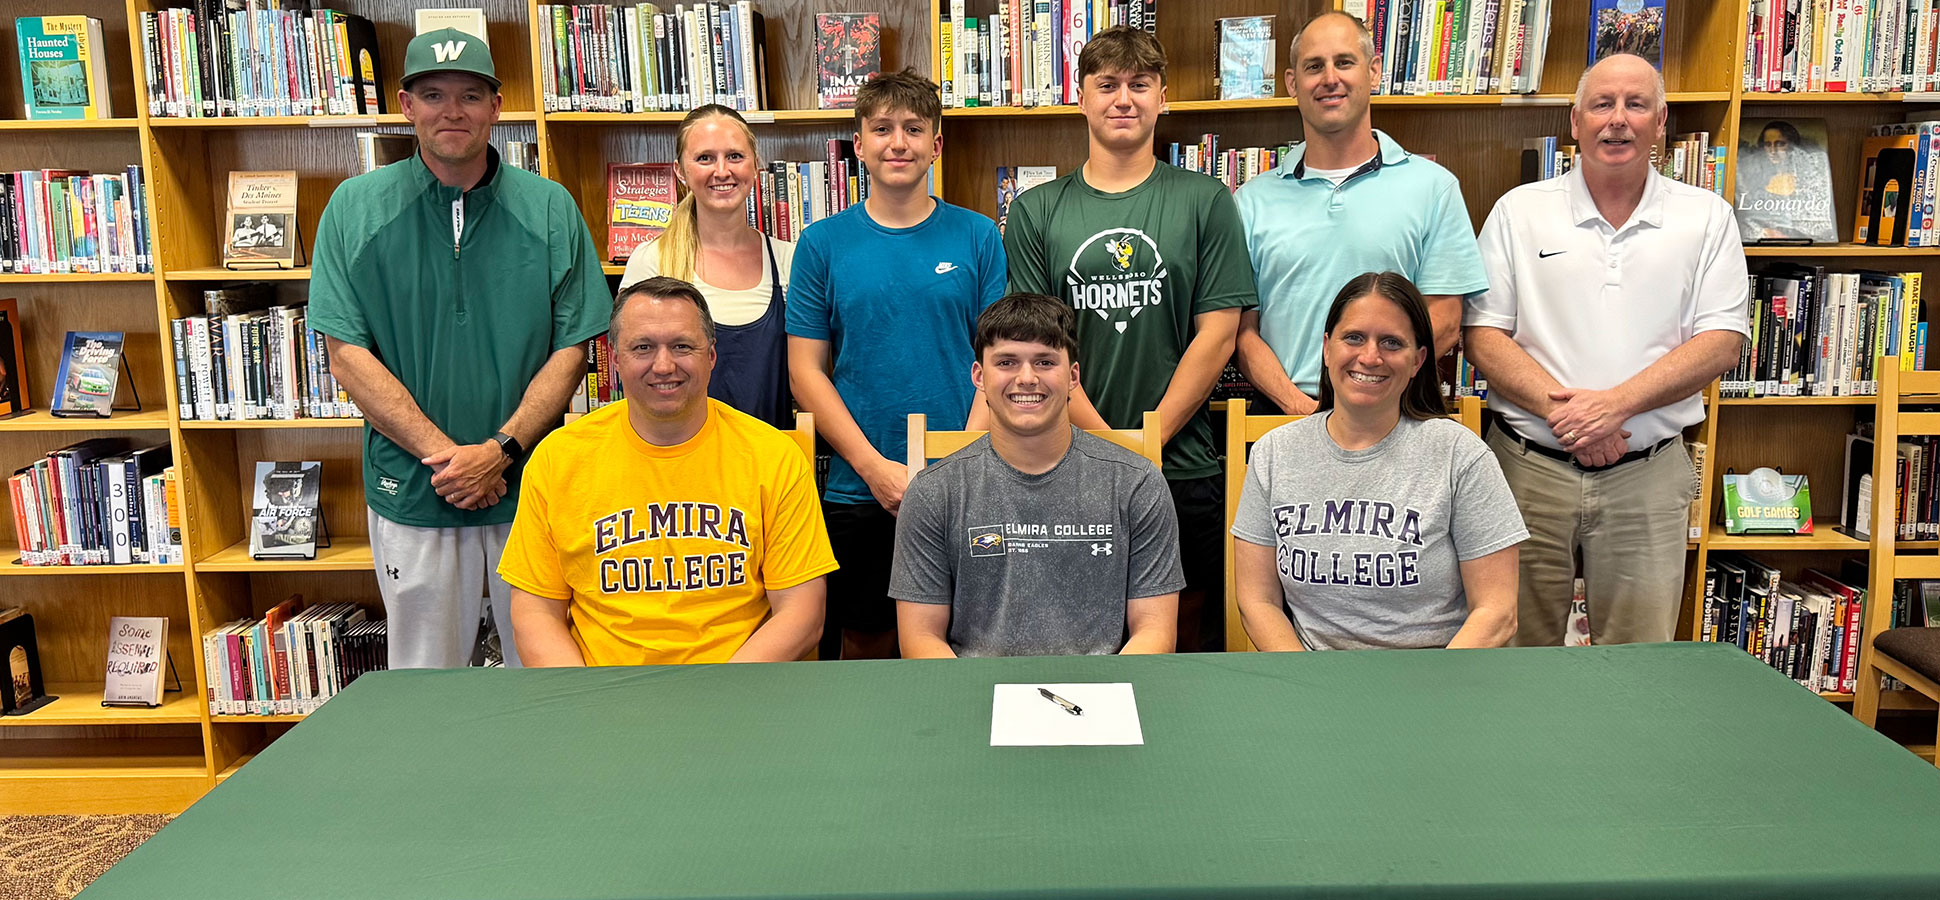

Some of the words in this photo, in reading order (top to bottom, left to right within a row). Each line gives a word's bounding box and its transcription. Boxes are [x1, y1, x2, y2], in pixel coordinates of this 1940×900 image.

[555, 9, 562, 17] 13
[697, 8, 705, 19] THE
[1022, 0, 1030, 41] AMMALS
[1483, 2, 1499, 43] Herbs
[47, 22, 57, 31] The
[60, 22, 82, 32] Mystery
[170, 17, 179, 50] LEARNING
[555, 18, 563, 40] HOURS
[698, 20, 706, 34] LAST
[722, 22, 730, 42] LUCKY
[999, 3, 1010, 58] BEARS
[1375, 7, 1386, 56] Fundamental
[1444, 13, 1452, 41] Backyard
[1834, 14, 1846, 38] Really
[1920, 15, 1928, 46] PROJECTS
[27, 36, 69, 48] Haunted
[700, 35, 708, 55] VICTIM
[1043, 28, 1051, 66] MARINE
[1510, 33, 1516, 41] IN
[1515, 24, 1526, 61] HORSES
[1835, 39, 1844, 55] Cool
[29, 47, 63, 58] Houses
[431, 40, 467, 64] W
[1456, 40, 1466, 73] Northeast
[1447, 54, 1455, 82] HARVES
[1832, 56, 1842, 72] Stu
[823, 86, 861, 99] HUNTE
[616, 170, 667, 186] LIFE
[1917, 170, 1925, 187] CRAFT
[1927, 158, 1938, 193] Crochet
[247, 184, 271, 192] Tinker
[616, 179, 668, 198] Strategies
[778, 178, 786, 201] NATURAL
[1738, 192, 1826, 211] Leonardo
[1914, 187, 1924, 213] PROJECTS
[617, 204, 671, 224] TEENS
[614, 233, 629, 244] Jay
[631, 233, 658, 242] McGr
[1091, 272, 1147, 281] WELLSBORO
[1072, 279, 1162, 310] HORNETS
[1797, 288, 1806, 309] Classical
[1912, 278, 1920, 305] MAKE
[1796, 309, 1804, 324] Music
[173, 322, 183, 341] Killing
[197, 324, 207, 358] COLIN
[208, 316, 223, 357] WAR
[251, 326, 260, 347] FUTURE
[1867, 325, 1875, 357] COMMANDER
[1908, 323, 1916, 353] LAUGH
[79, 346, 115, 358] Driving
[85, 340, 103, 349] The
[176, 341, 185, 359] Patton
[587, 340, 595, 364] Cloning
[82, 356, 109, 364] Force
[253, 350, 261, 364] WAR
[201, 364, 211, 402] POWELL
[258, 508, 277, 517] AIR
[278, 508, 313, 517] FORCE
[1273, 498, 1424, 547] ELMIRA
[1737, 506, 1762, 518] GOLF
[1763, 506, 1800, 519] GAMES
[595, 502, 751, 555] ELMIRA
[1006, 524, 1048, 536] ELMIRA
[1054, 524, 1113, 536] COLLEGE
[600, 552, 747, 593] COLLEGE
[1277, 544, 1419, 588] COLLEGE
[1706, 579, 1714, 597] The
[1732, 597, 1741, 610] 75
[1767, 592, 1777, 620] College
[1703, 598, 1713, 634] Football
[1852, 612, 1860, 622] FOR
[1728, 615, 1740, 642] SEAS
[1757, 622, 1765, 638] LET'S
[1765, 620, 1774, 647] Football
[1850, 623, 1859, 632] THE
[1824, 625, 1833, 660] TEBOW
[1849, 632, 1858, 647] GLORY
[1788, 645, 1796, 664] TERRELL
[1847, 654, 1855, 668] THEIR
[107, 660, 158, 677] REQUIRED
